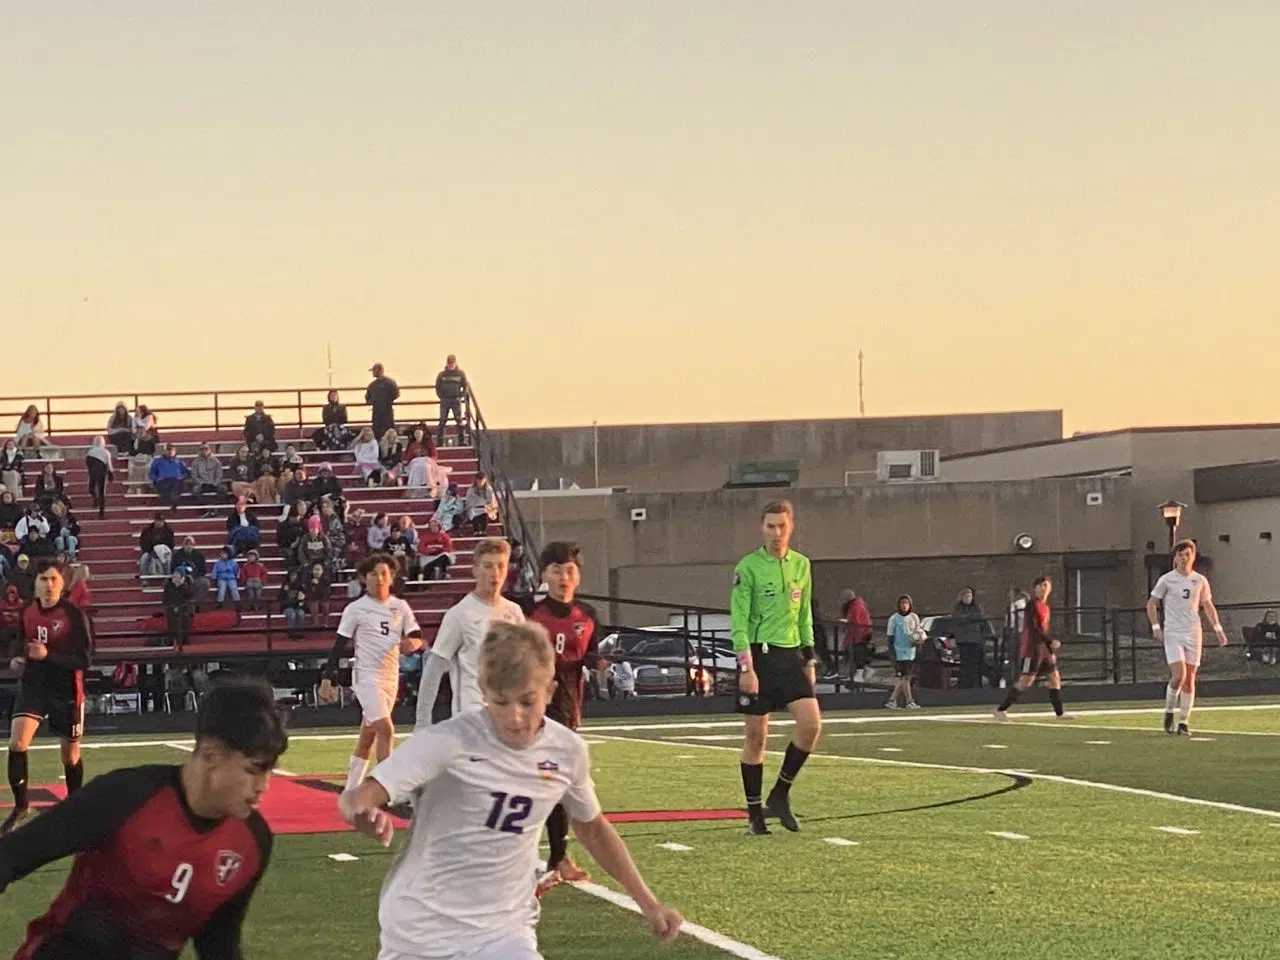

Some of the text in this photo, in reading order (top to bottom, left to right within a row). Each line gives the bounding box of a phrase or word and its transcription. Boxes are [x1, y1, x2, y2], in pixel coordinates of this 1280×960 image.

[1182, 588, 1191, 600] 3
[37, 624, 49, 644] 19
[380, 621, 390, 636] 5
[556, 632, 566, 655] 8
[485, 791, 534, 835] 12
[164, 862, 194, 904] 9
